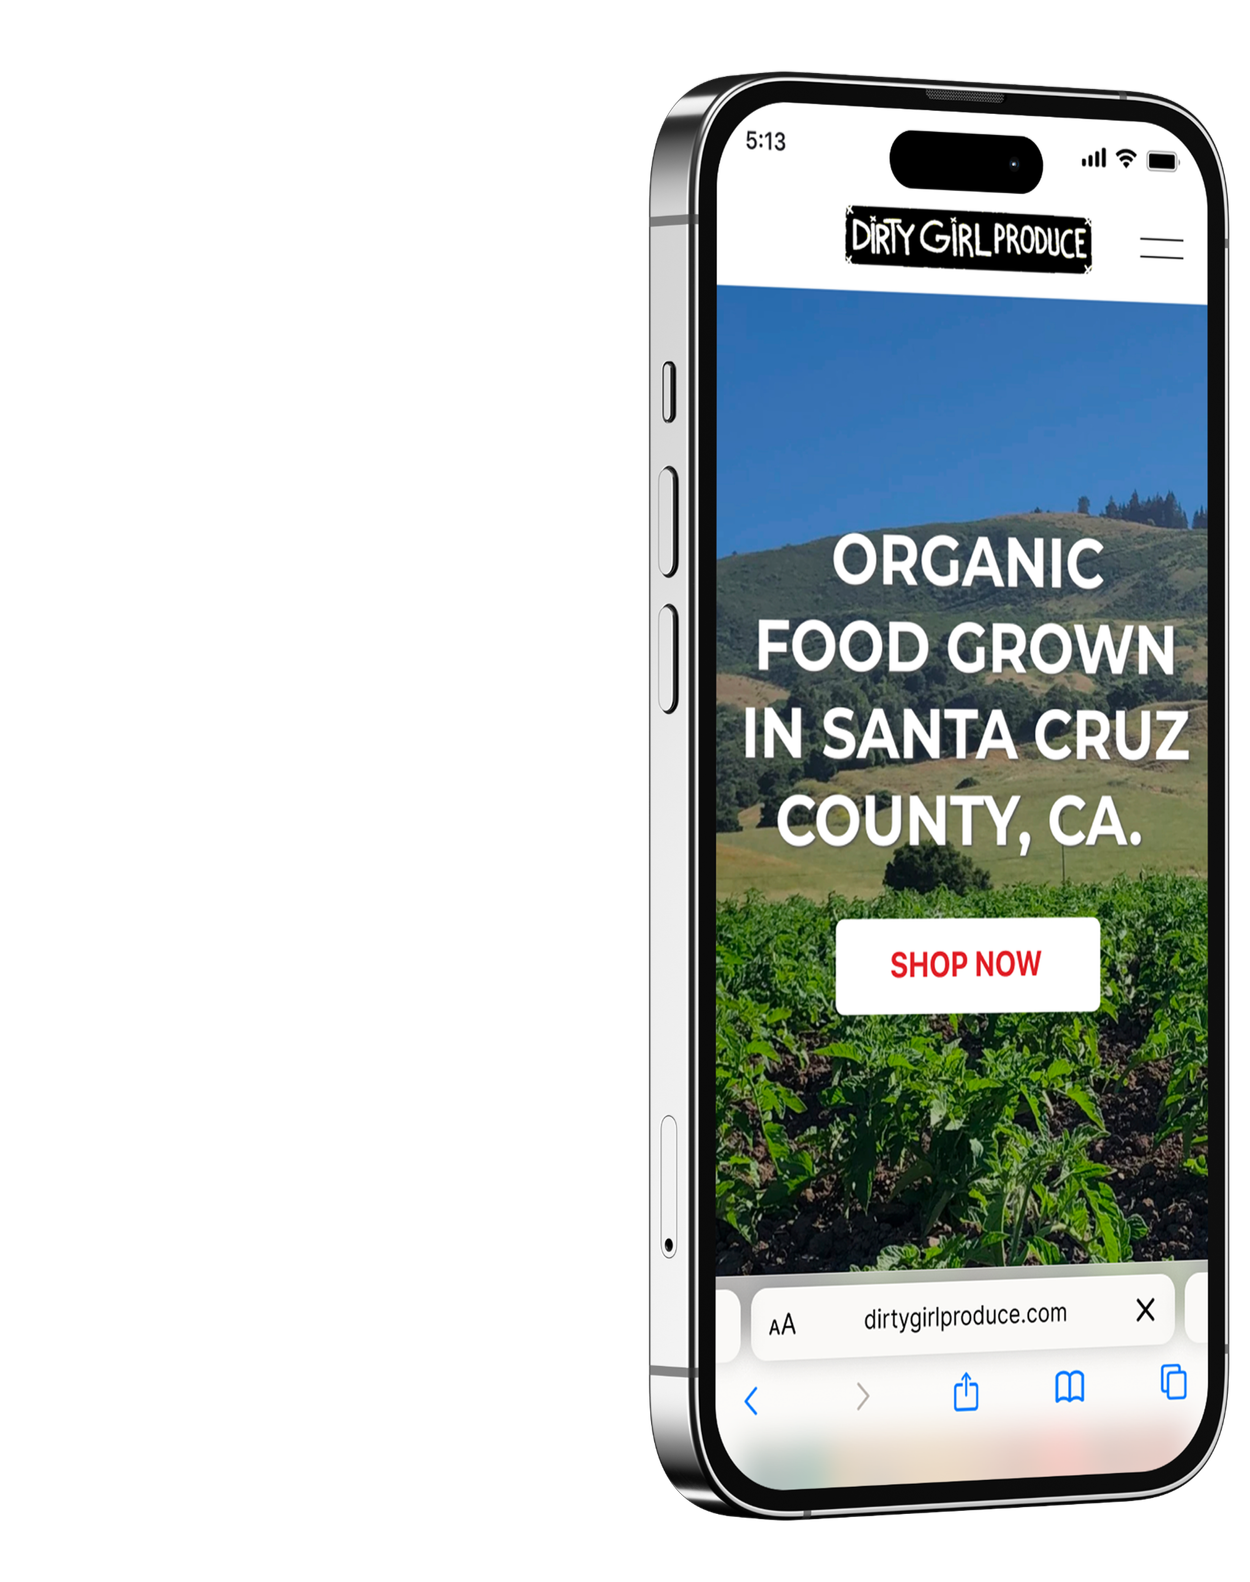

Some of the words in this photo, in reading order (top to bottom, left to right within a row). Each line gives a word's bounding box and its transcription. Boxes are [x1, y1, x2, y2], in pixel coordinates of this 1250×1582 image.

[745, 130, 786, 152] 5:13
[994, 222, 1087, 259] PRODUCE
[832, 532, 1105, 590] ORGANIC
[757, 619, 930, 673] FOOD
[947, 622, 1175, 675] GROWN
[744, 707, 802, 759] IN
[823, 707, 1019, 760] SANTA
[1035, 709, 1191, 761] CRUZ
[776, 795, 1032, 857] COUNTY,
[1049, 795, 1142, 847] CA.
[890, 951, 968, 979] SHOP
[975, 949, 1042, 977] NOW
[864, 1304, 1067, 1334] dirtygirlproduce.com
